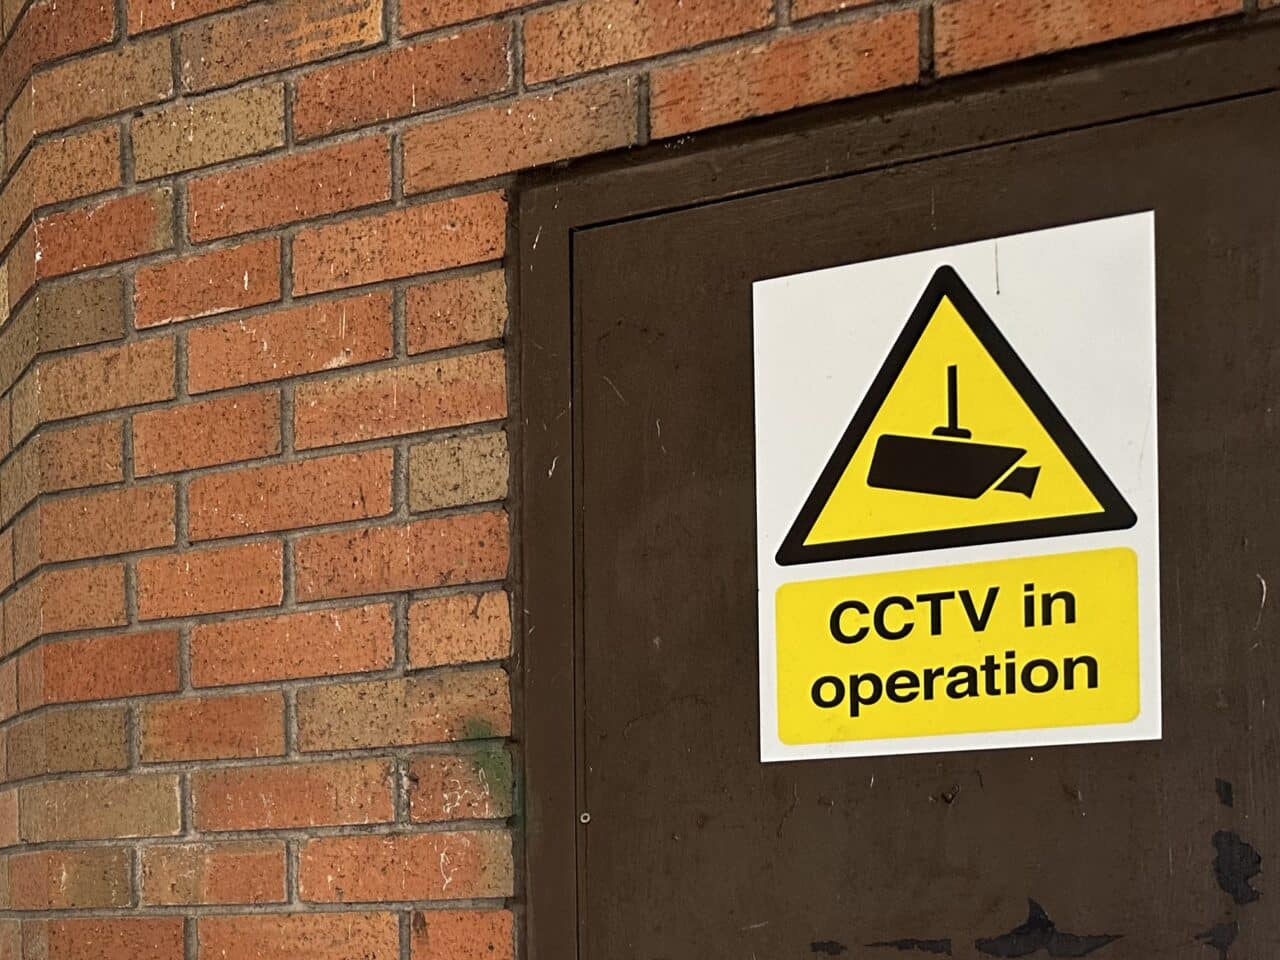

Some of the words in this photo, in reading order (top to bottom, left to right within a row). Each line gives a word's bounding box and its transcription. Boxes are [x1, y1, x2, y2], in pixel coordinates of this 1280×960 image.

[828, 586, 1000, 645] CCTV
[1023, 583, 1076, 628] in
[810, 650, 1099, 718] operation
